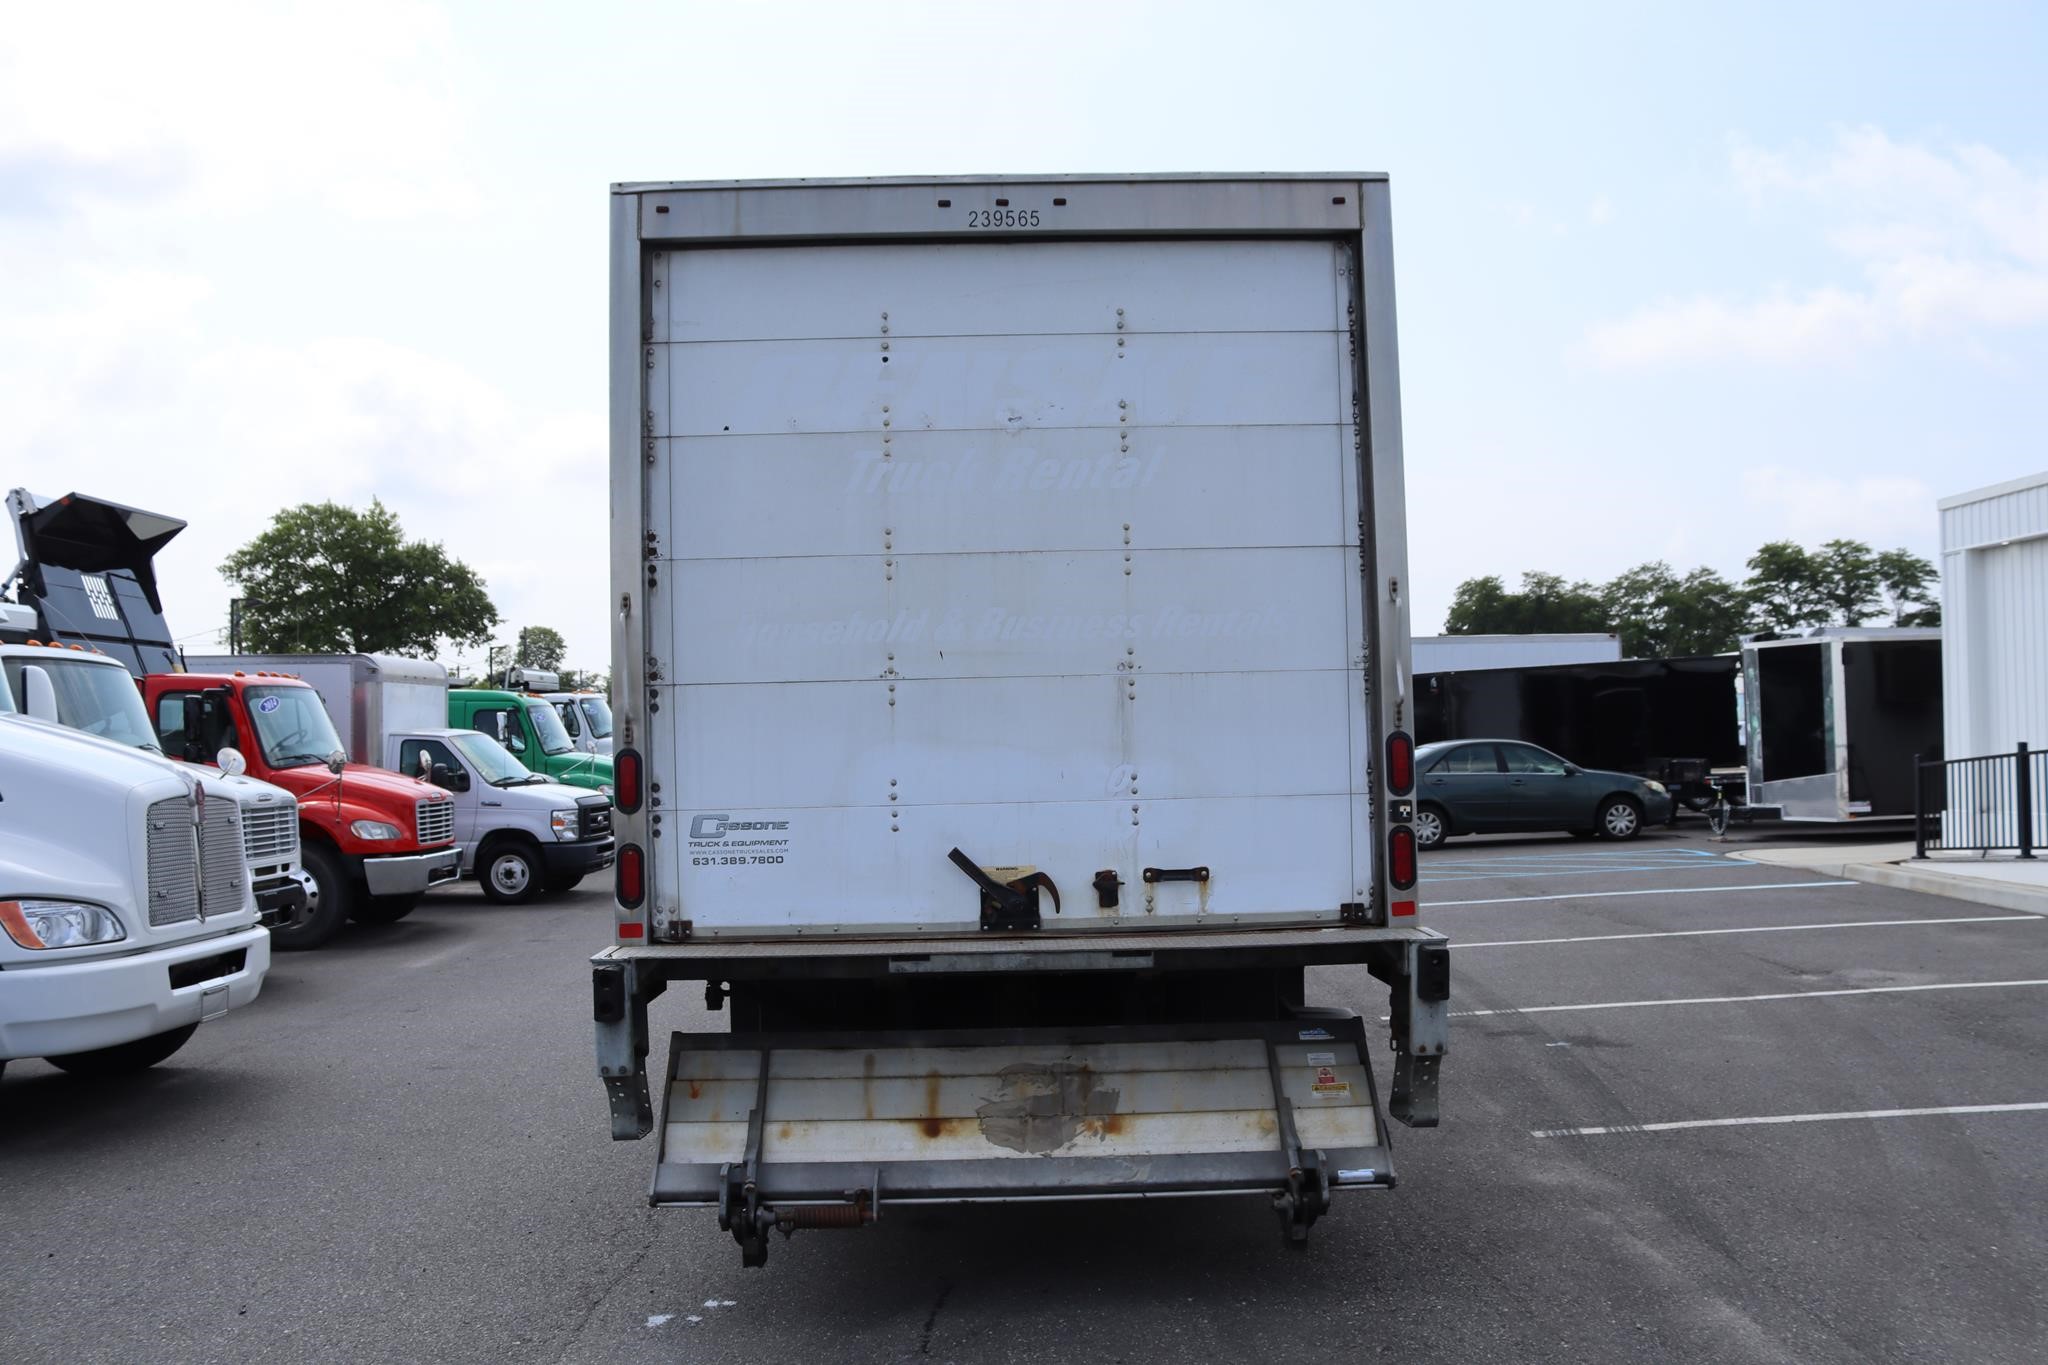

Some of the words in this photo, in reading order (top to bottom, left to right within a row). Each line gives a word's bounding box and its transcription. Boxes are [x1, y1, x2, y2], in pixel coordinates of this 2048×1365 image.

[968, 210, 1040, 228] 239565
[844, 447, 981, 495] Truck
[992, 445, 1169, 492] Rental
[976, 605, 1143, 644] Business
[692, 856, 784, 865] 631.389.7800
